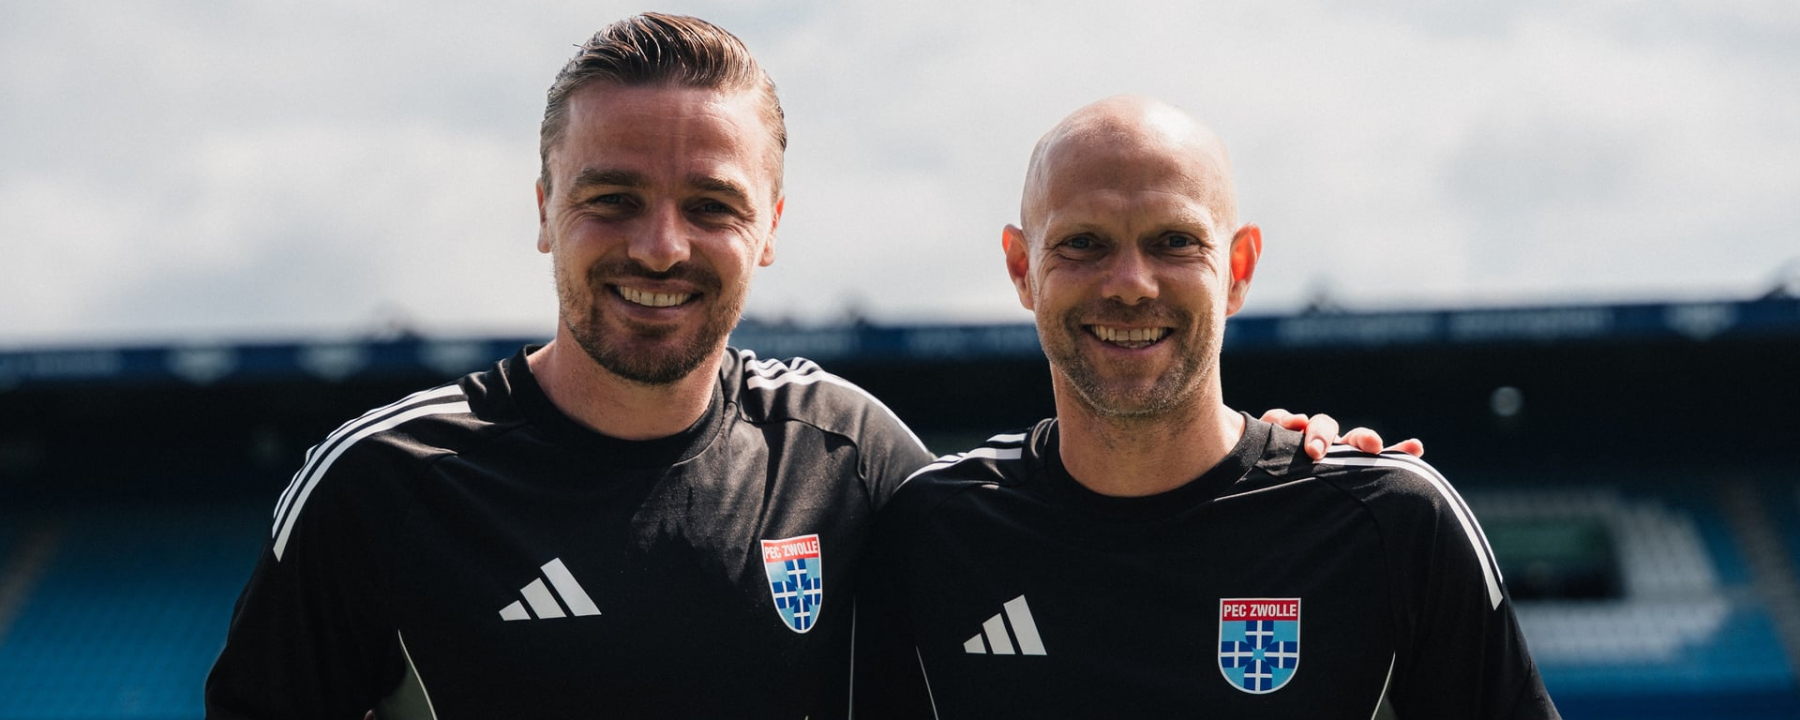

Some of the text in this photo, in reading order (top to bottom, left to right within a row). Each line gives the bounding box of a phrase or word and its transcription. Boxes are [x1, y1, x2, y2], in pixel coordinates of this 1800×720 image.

[764, 541, 818, 559] PEC ZWOLLE
[1223, 604, 1297, 617] PEC ZWOLLE
